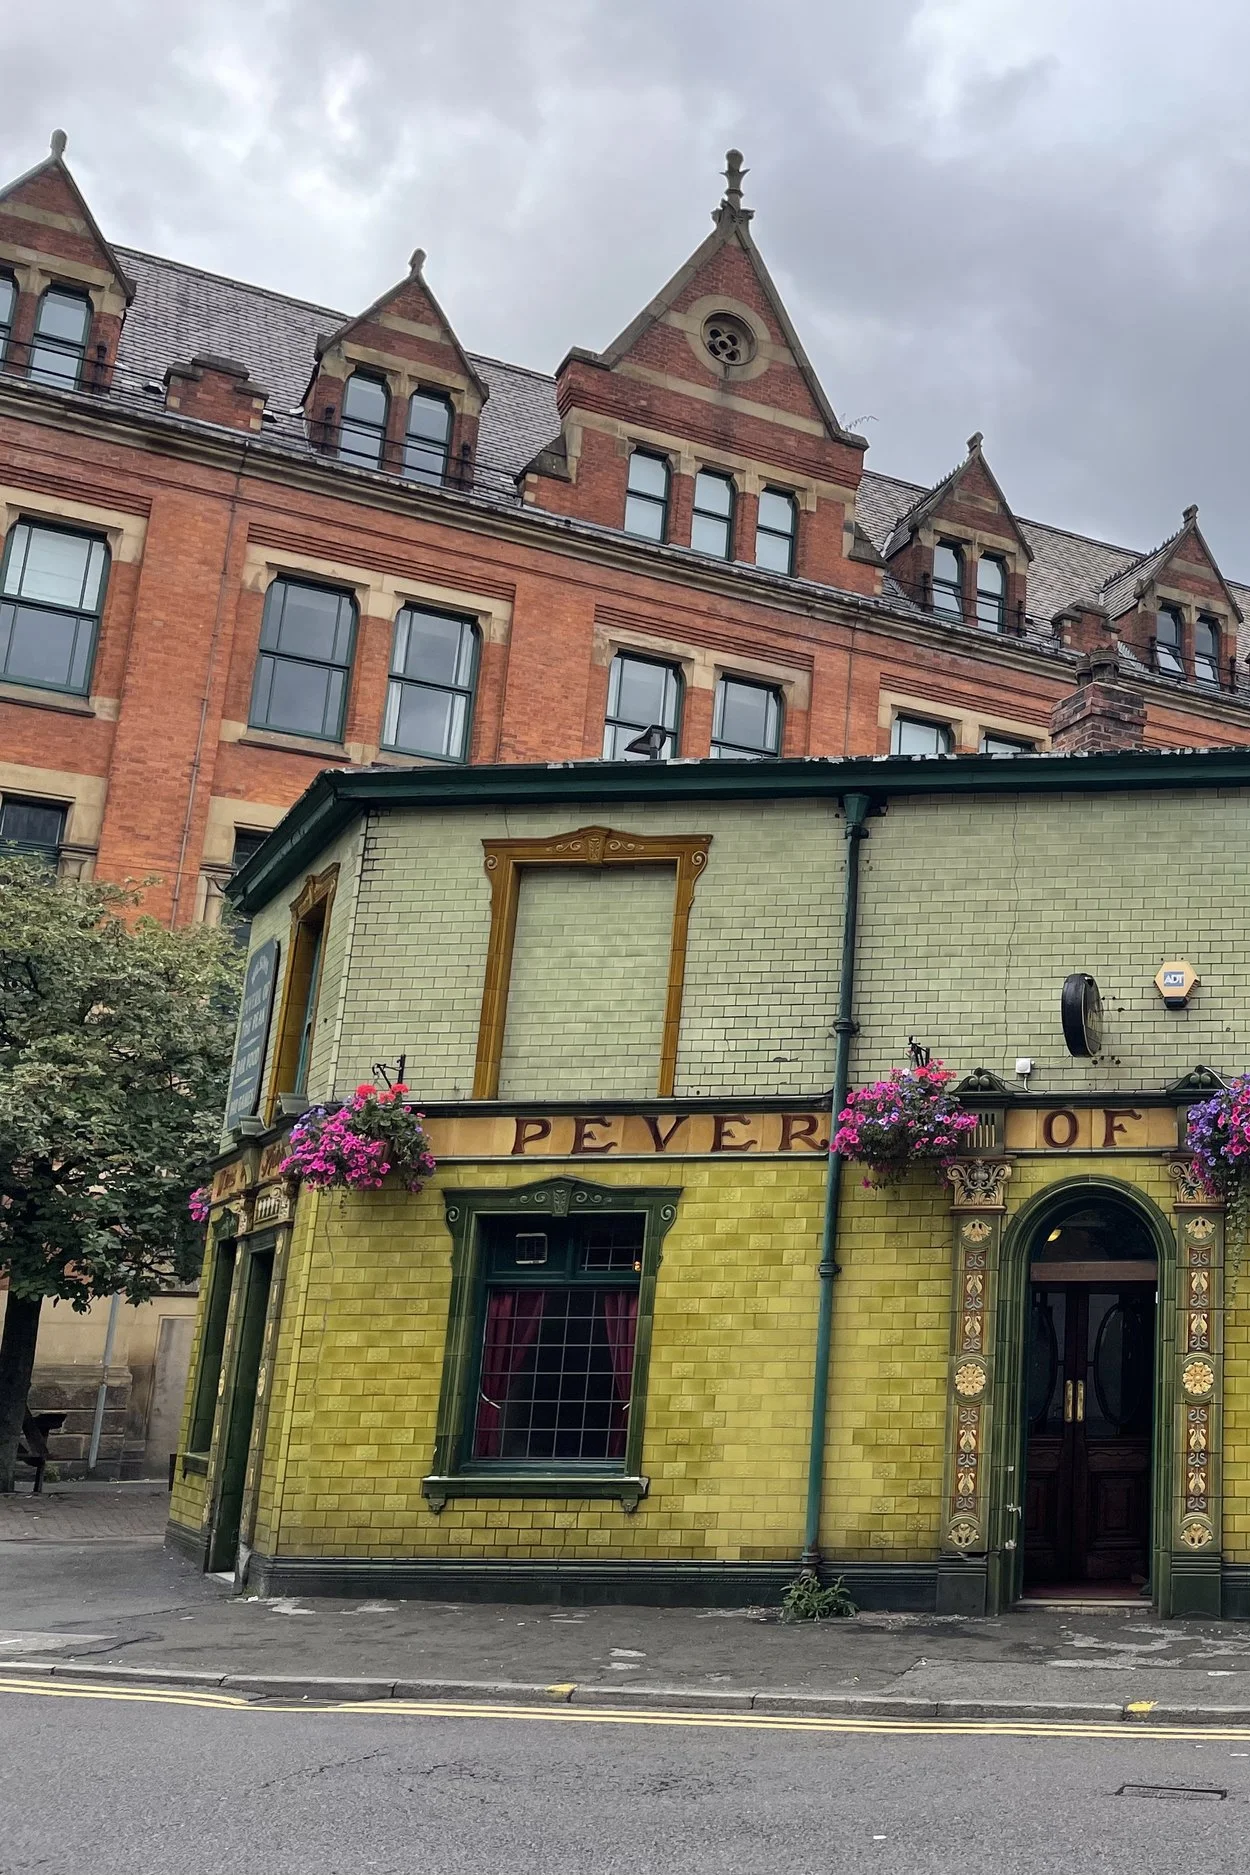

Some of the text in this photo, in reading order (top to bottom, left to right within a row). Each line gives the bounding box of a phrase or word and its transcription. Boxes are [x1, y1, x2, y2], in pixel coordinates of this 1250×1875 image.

[1163, 973, 1184, 985] ADT
[511, 1114, 829, 1154] PEVER
[1043, 1109, 1143, 1148] OF
